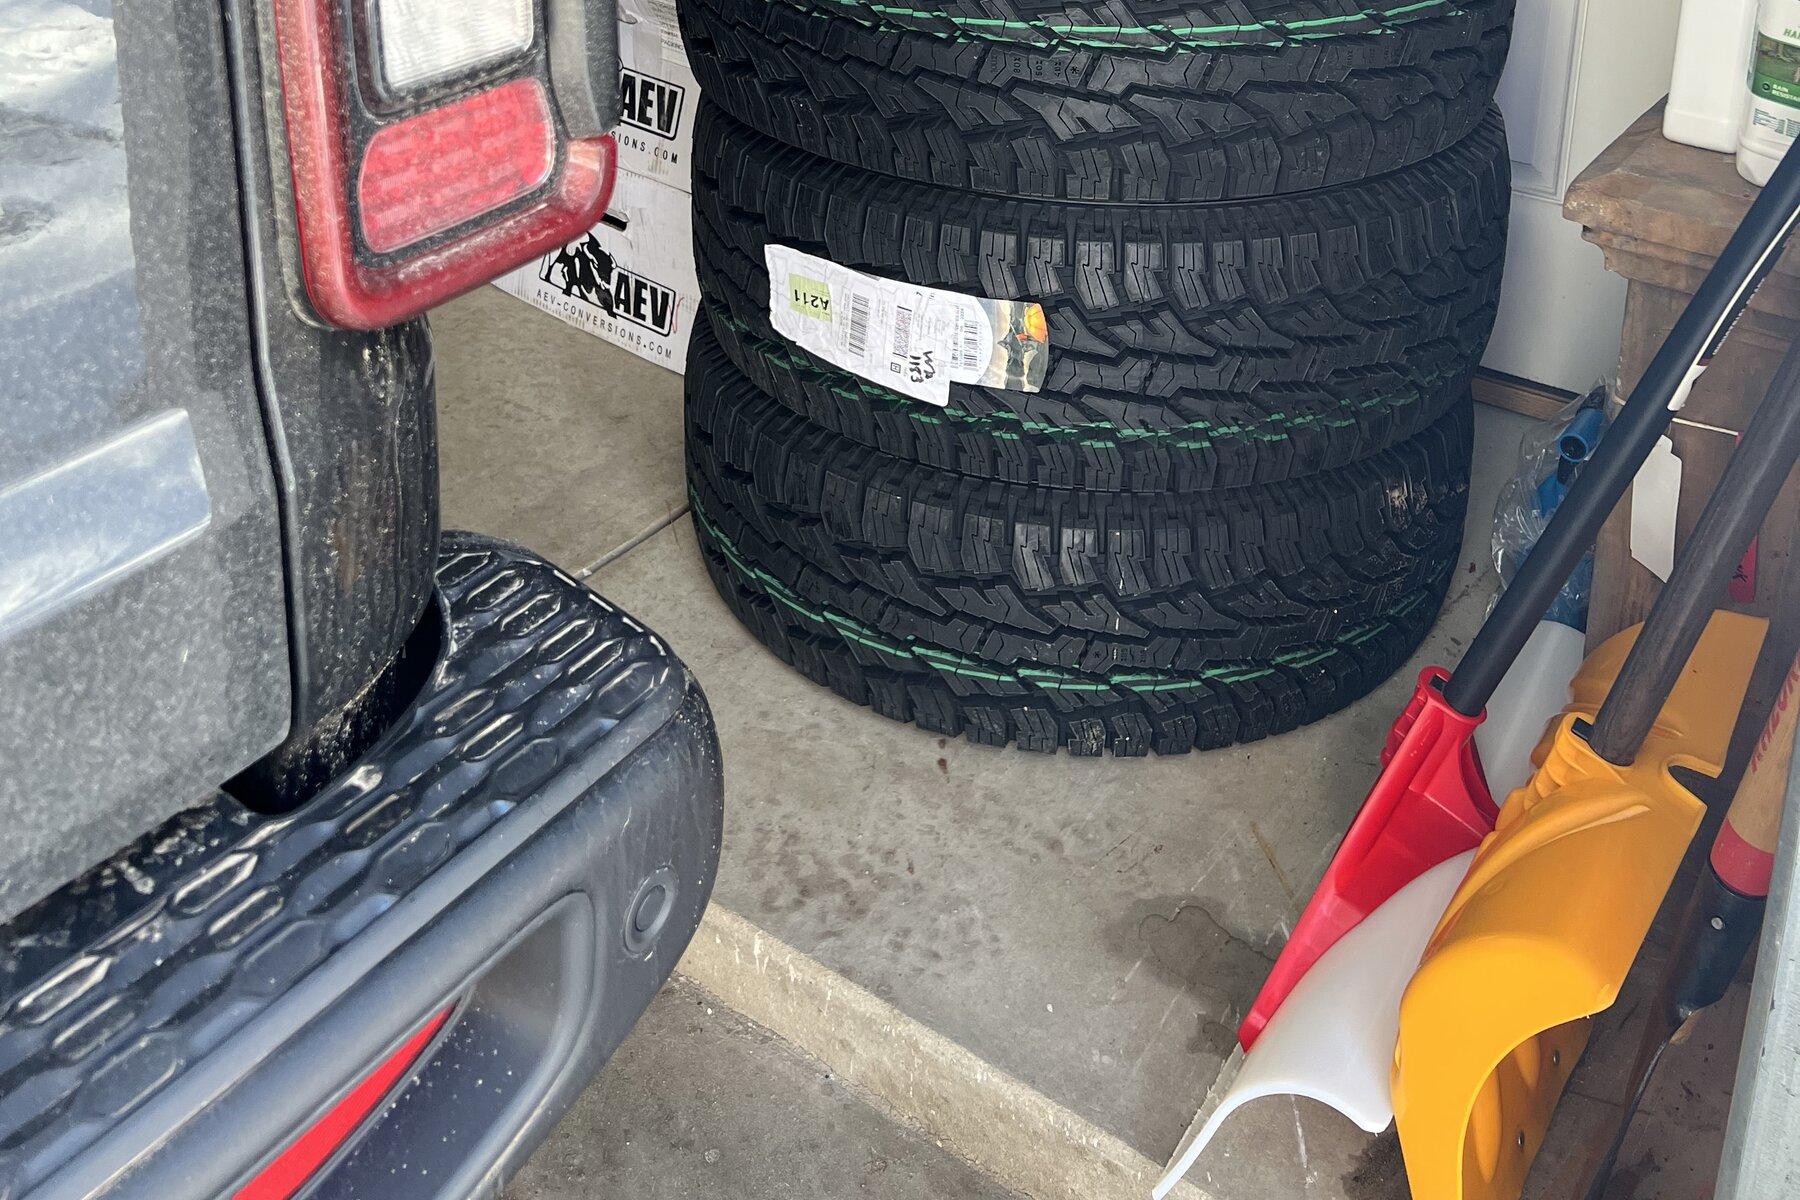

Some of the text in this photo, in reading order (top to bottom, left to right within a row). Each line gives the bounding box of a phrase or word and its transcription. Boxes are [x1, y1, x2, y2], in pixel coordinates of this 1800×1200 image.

[620, 73, 678, 134] AEV
[536, 288, 672, 358] AEV-CONVERSIONS.COM
[614, 271, 670, 330] AEV
[794, 289, 829, 311] A211
